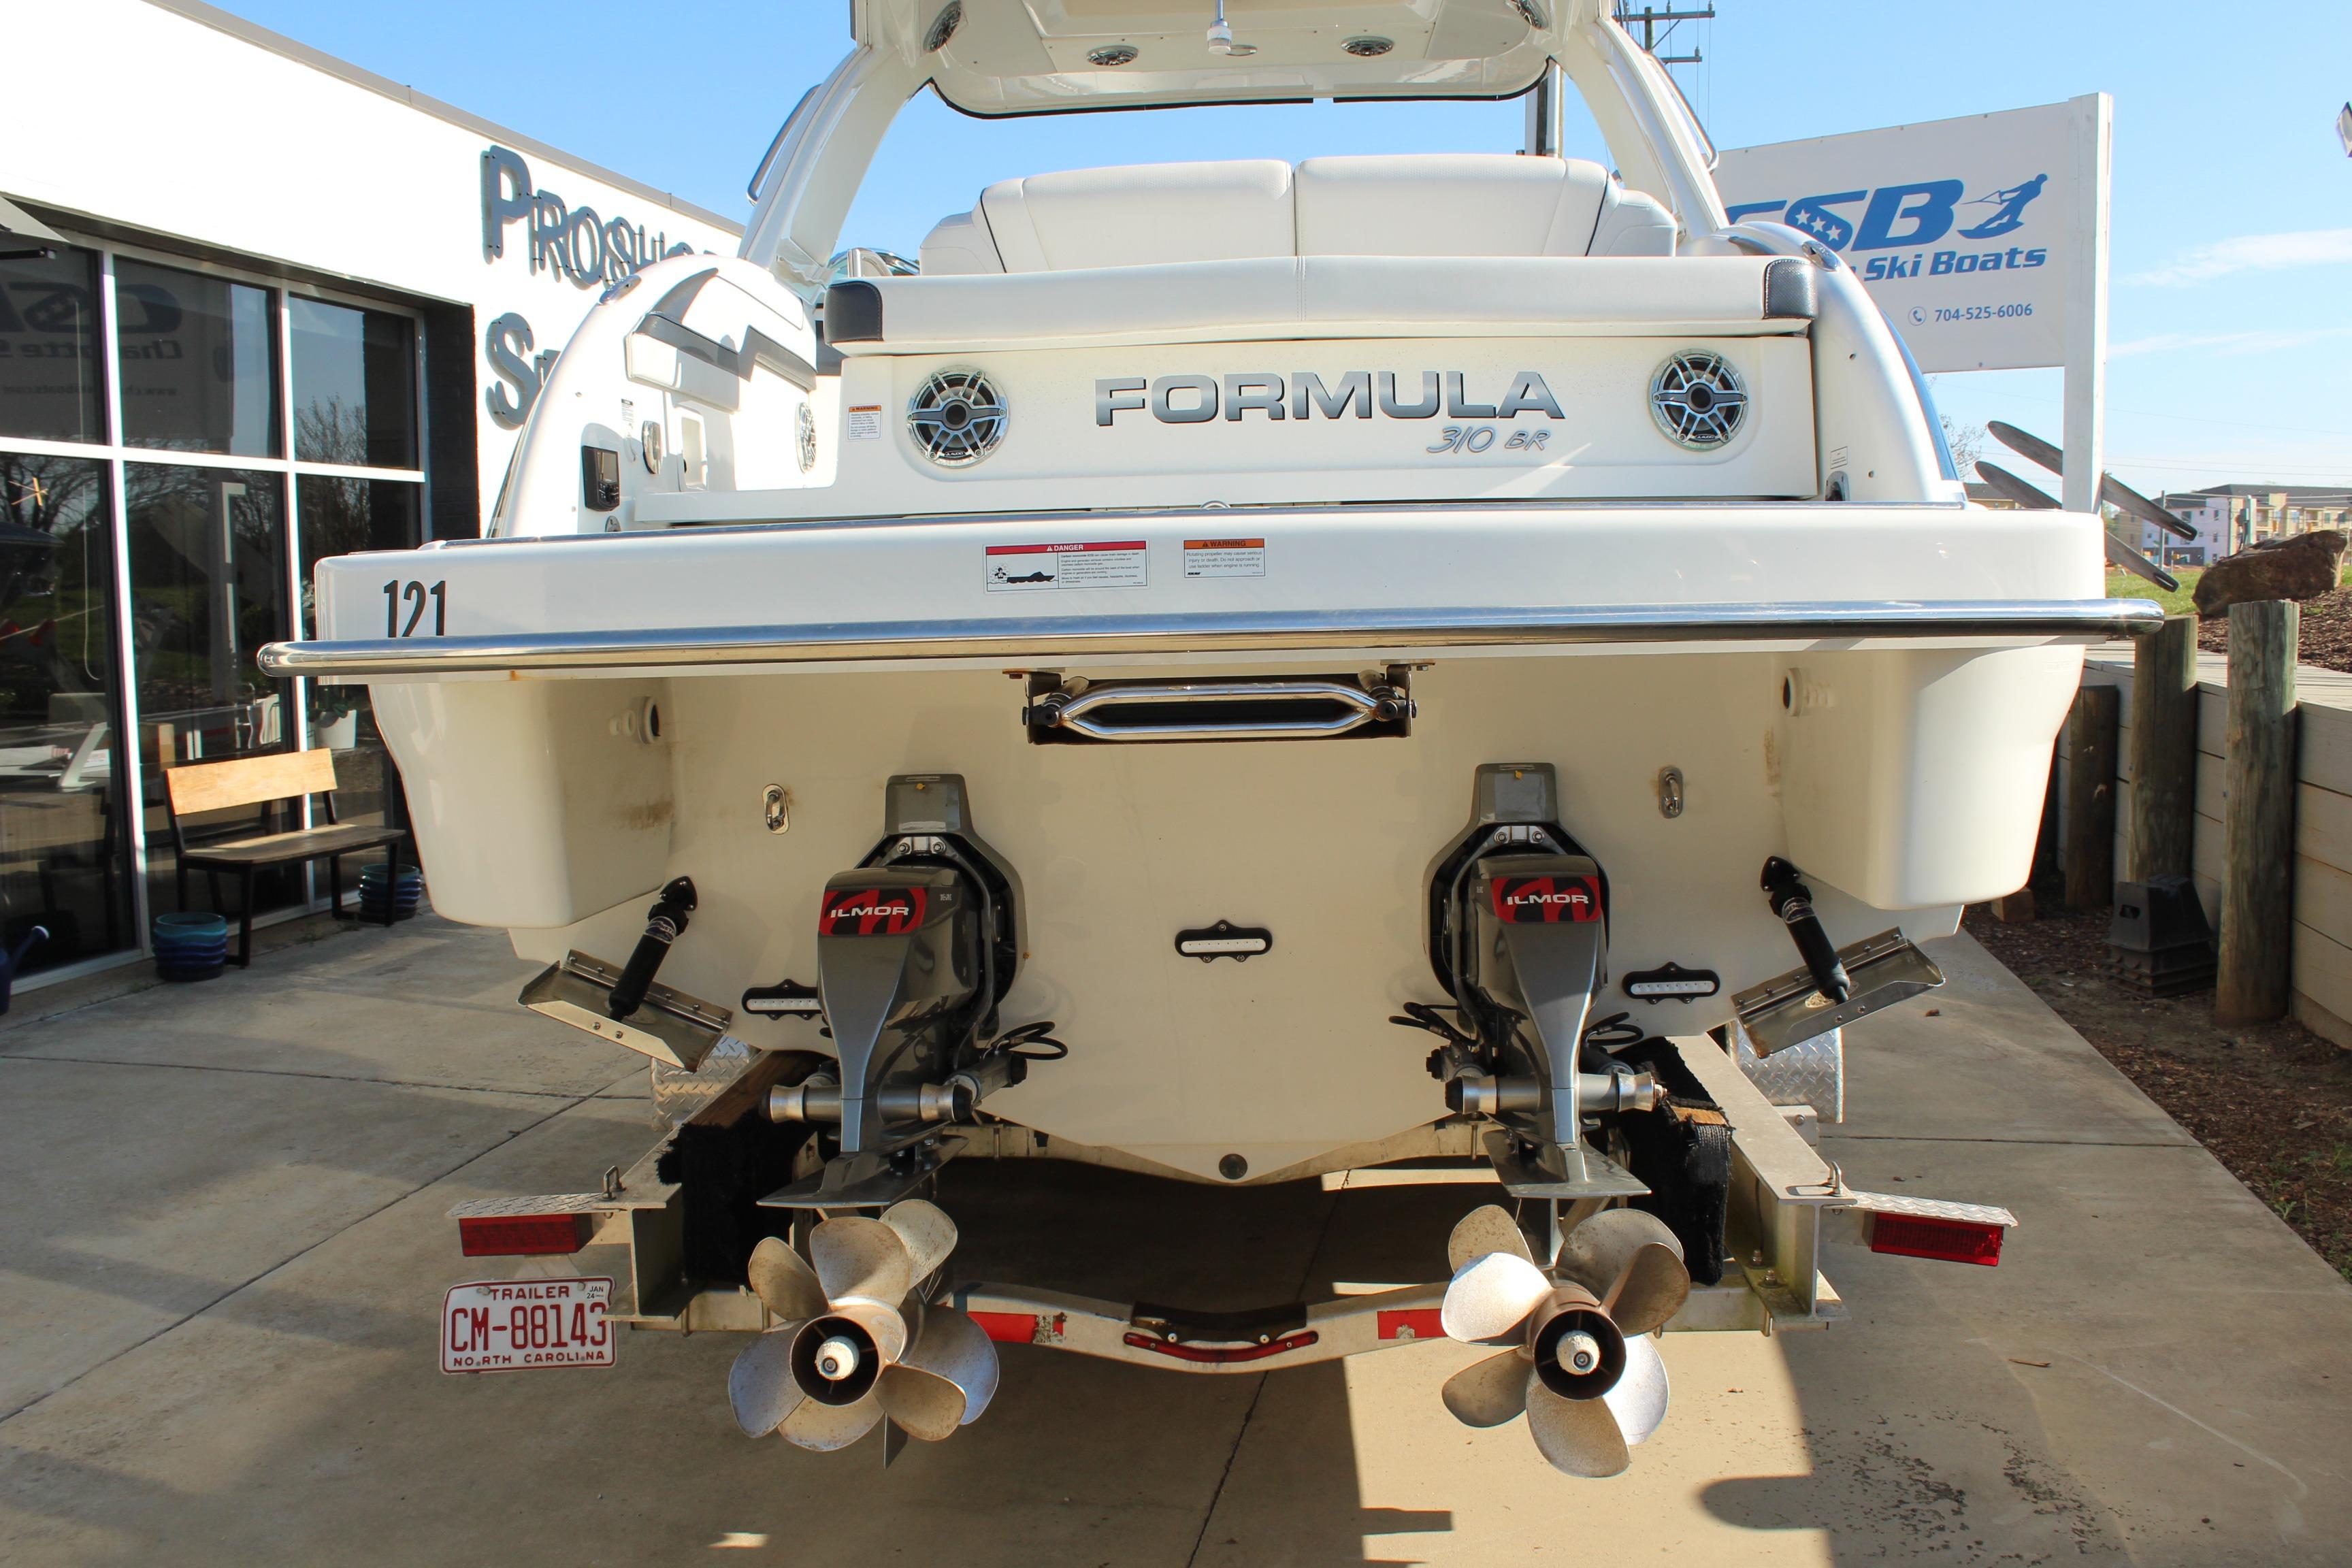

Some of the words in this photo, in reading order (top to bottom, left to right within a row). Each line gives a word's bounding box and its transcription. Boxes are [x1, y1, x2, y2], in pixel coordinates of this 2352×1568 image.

[1863, 253, 1923, 282] Ski
[1928, 247, 2048, 276] Boats
[1934, 303, 2033, 323] 704-525-6006
[1095, 371, 1566, 426] FORMULA
[1426, 425, 1497, 454] 310
[1503, 429, 1552, 451] BR
[384, 580, 446, 638] 121
[1507, 894, 1589, 905] ILMOR
[830, 906, 910, 918] ILMOR
[490, 1285, 570, 1301] TRAILER
[451, 1301, 607, 1352] CM-88143
[453, 1355, 512, 1367] NORTH
[523, 1350, 606, 1363] CAROLINA
